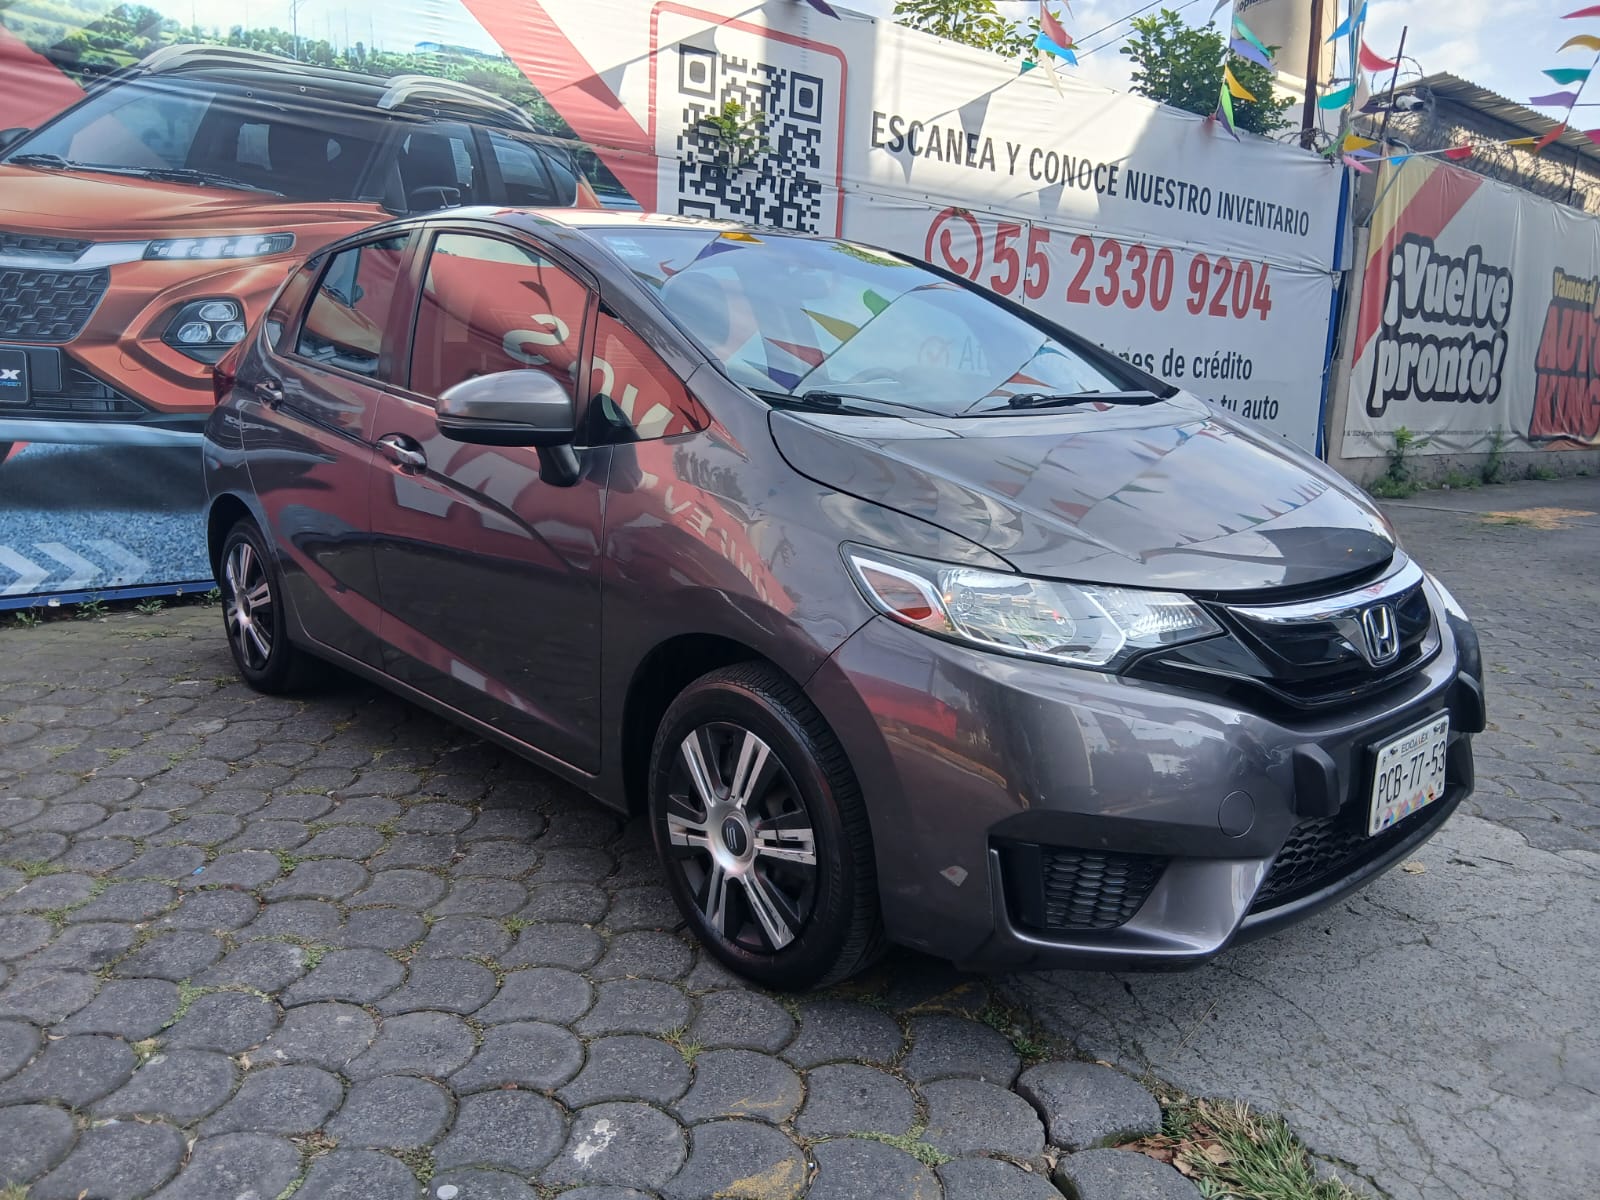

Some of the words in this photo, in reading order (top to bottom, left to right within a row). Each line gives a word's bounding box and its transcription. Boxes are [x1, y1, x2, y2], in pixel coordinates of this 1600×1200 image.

[871, 110, 996, 173] ESCANEA
[1006, 143, 1021, 176] Y
[1029, 147, 1119, 198] CONOCE
[1126, 169, 1212, 216] NUESTRO
[1217, 191, 1310, 237] INVENTARIO
[991, 222, 1050, 300] 55
[1067, 234, 1175, 312] 2330
[1187, 252, 1272, 321] 9204
[1382, 232, 1513, 330] ¡Vuelve
[1553, 267, 1586, 303] Vamos
[1162, 347, 1185, 378] de
[1193, 350, 1253, 381] crédito
[1366, 330, 1508, 417] pronto!
[1242, 395, 1279, 421] auto
[1376, 740, 1446, 811] PCB-77-53
